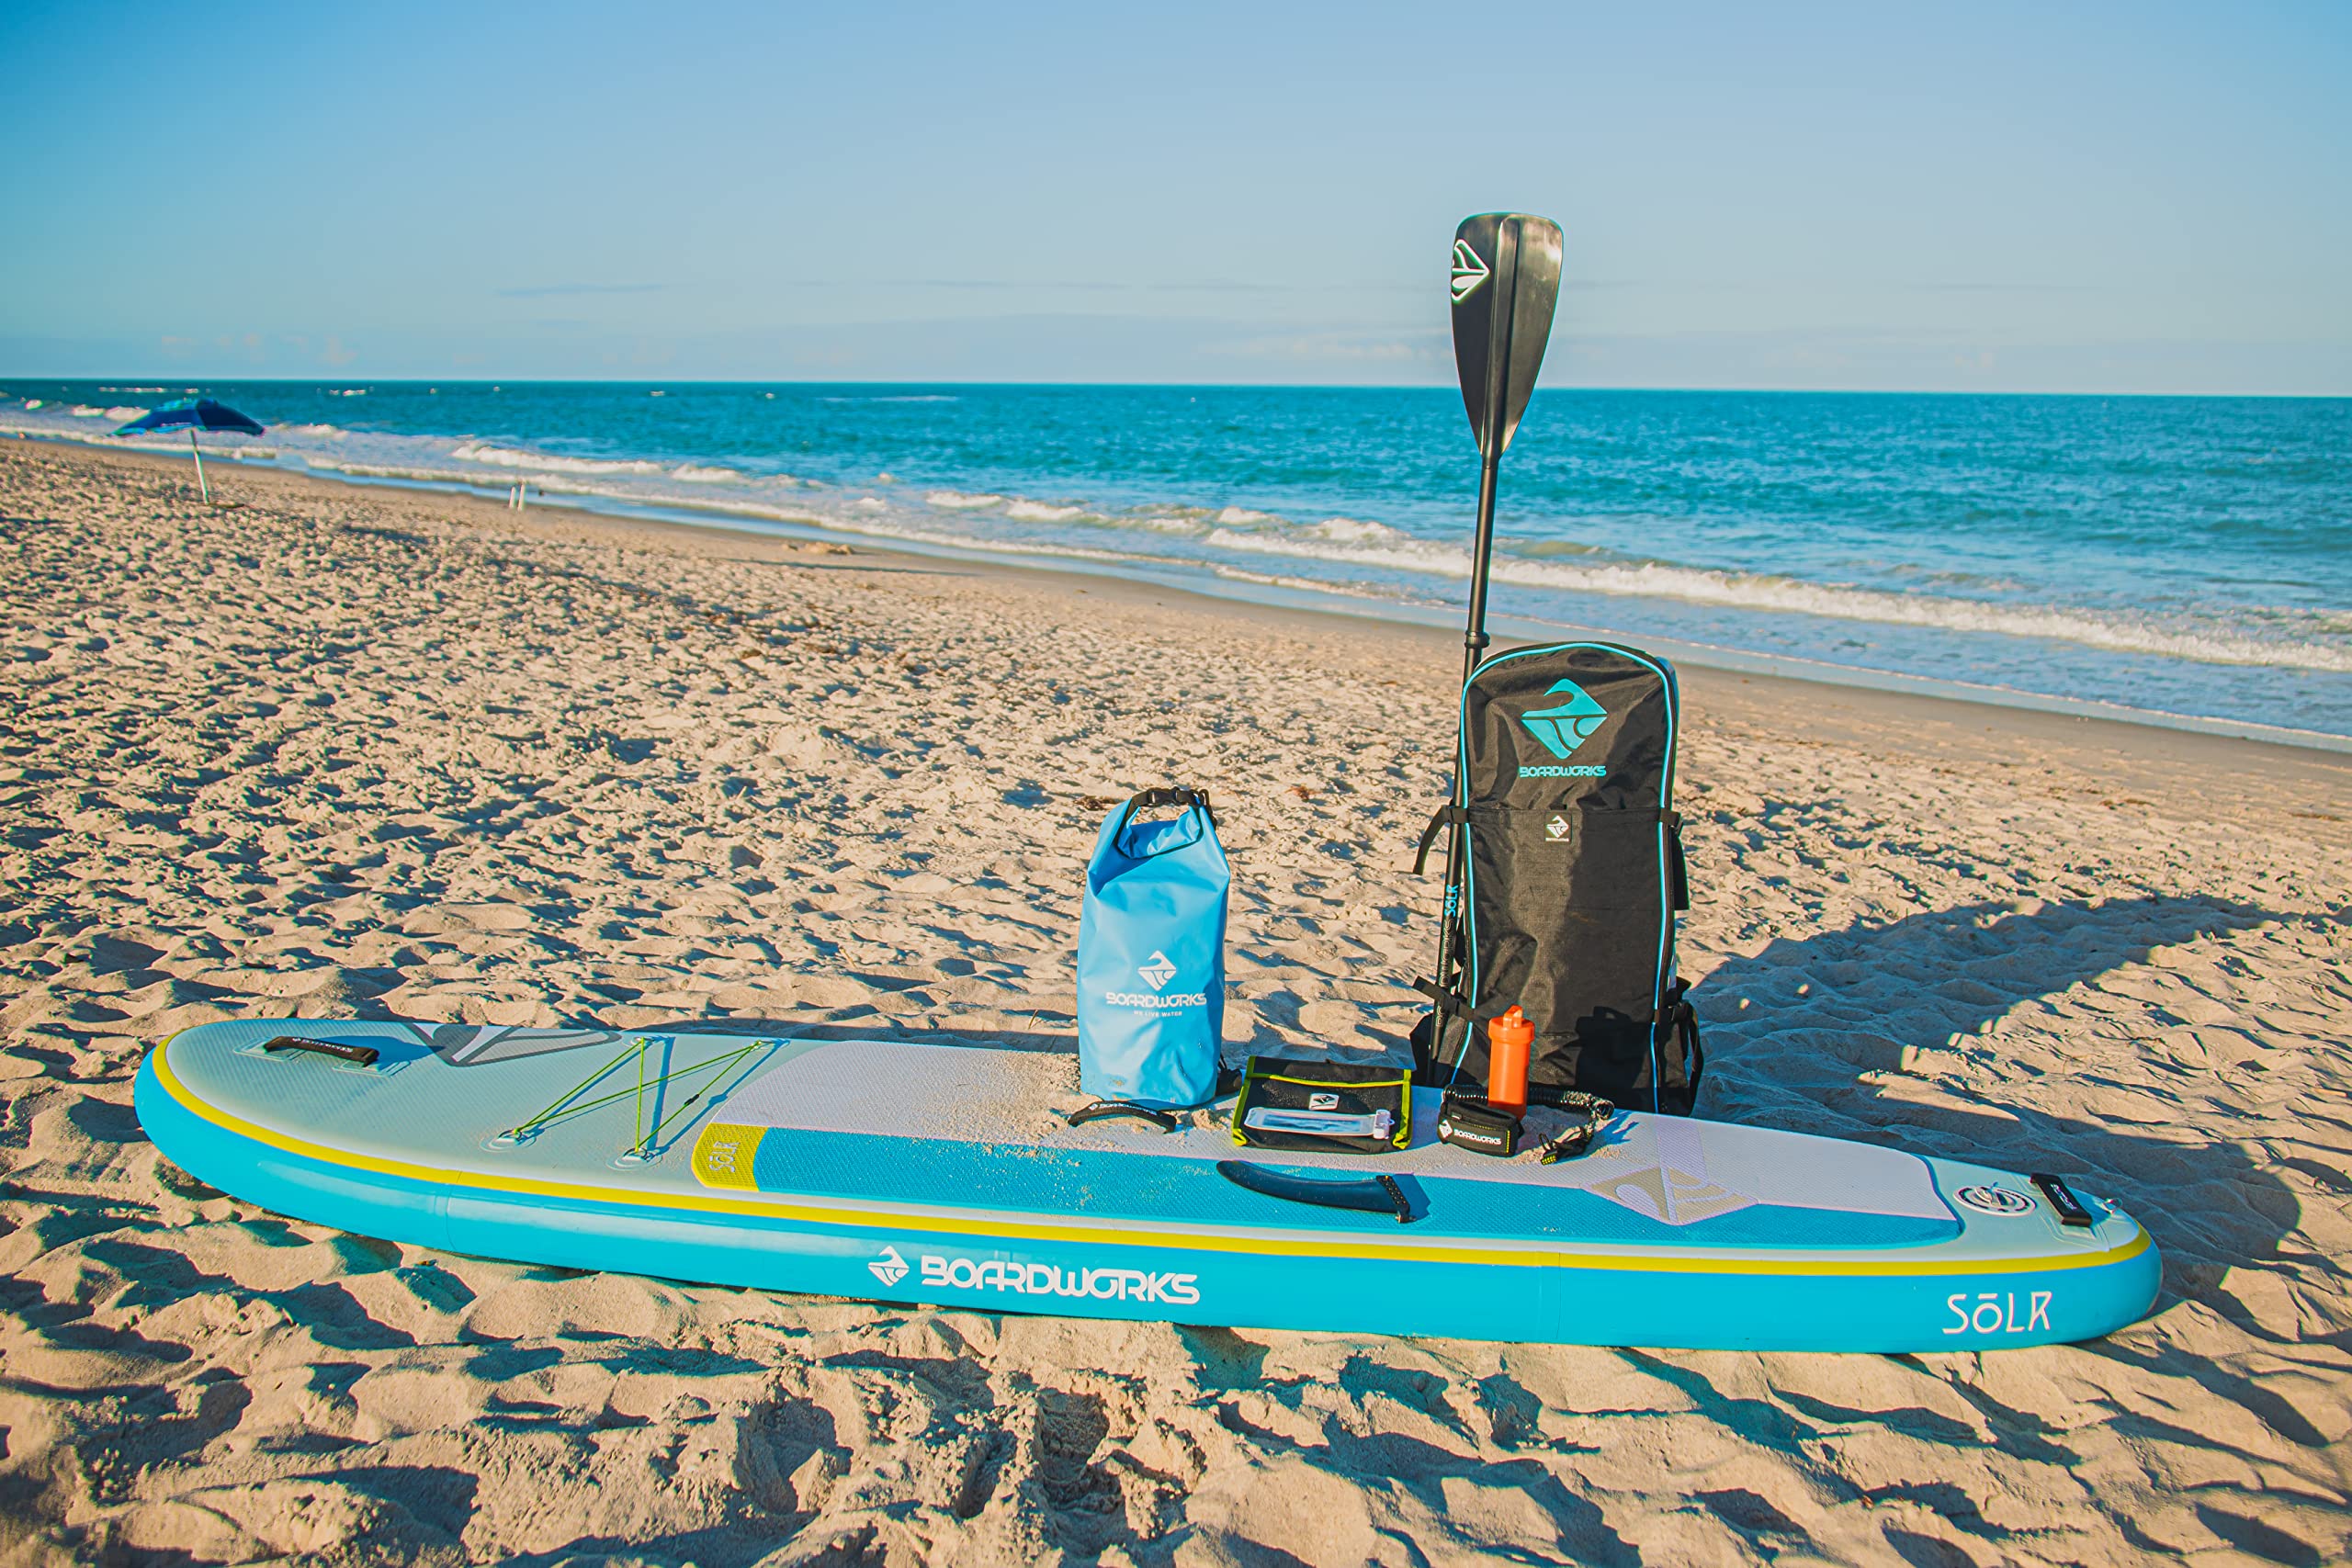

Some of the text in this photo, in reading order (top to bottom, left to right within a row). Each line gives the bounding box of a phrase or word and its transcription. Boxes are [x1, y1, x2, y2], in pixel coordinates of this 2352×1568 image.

[1519, 765, 1607, 778] BOARDWORKS
[1435, 919, 1453, 1027] BODWORKS
[1105, 991, 1207, 1009] BOARDWORKS
[1453, 1128, 1502, 1145] BOARDWORKS
[921, 1255, 1201, 1305] BOARDWORKS
